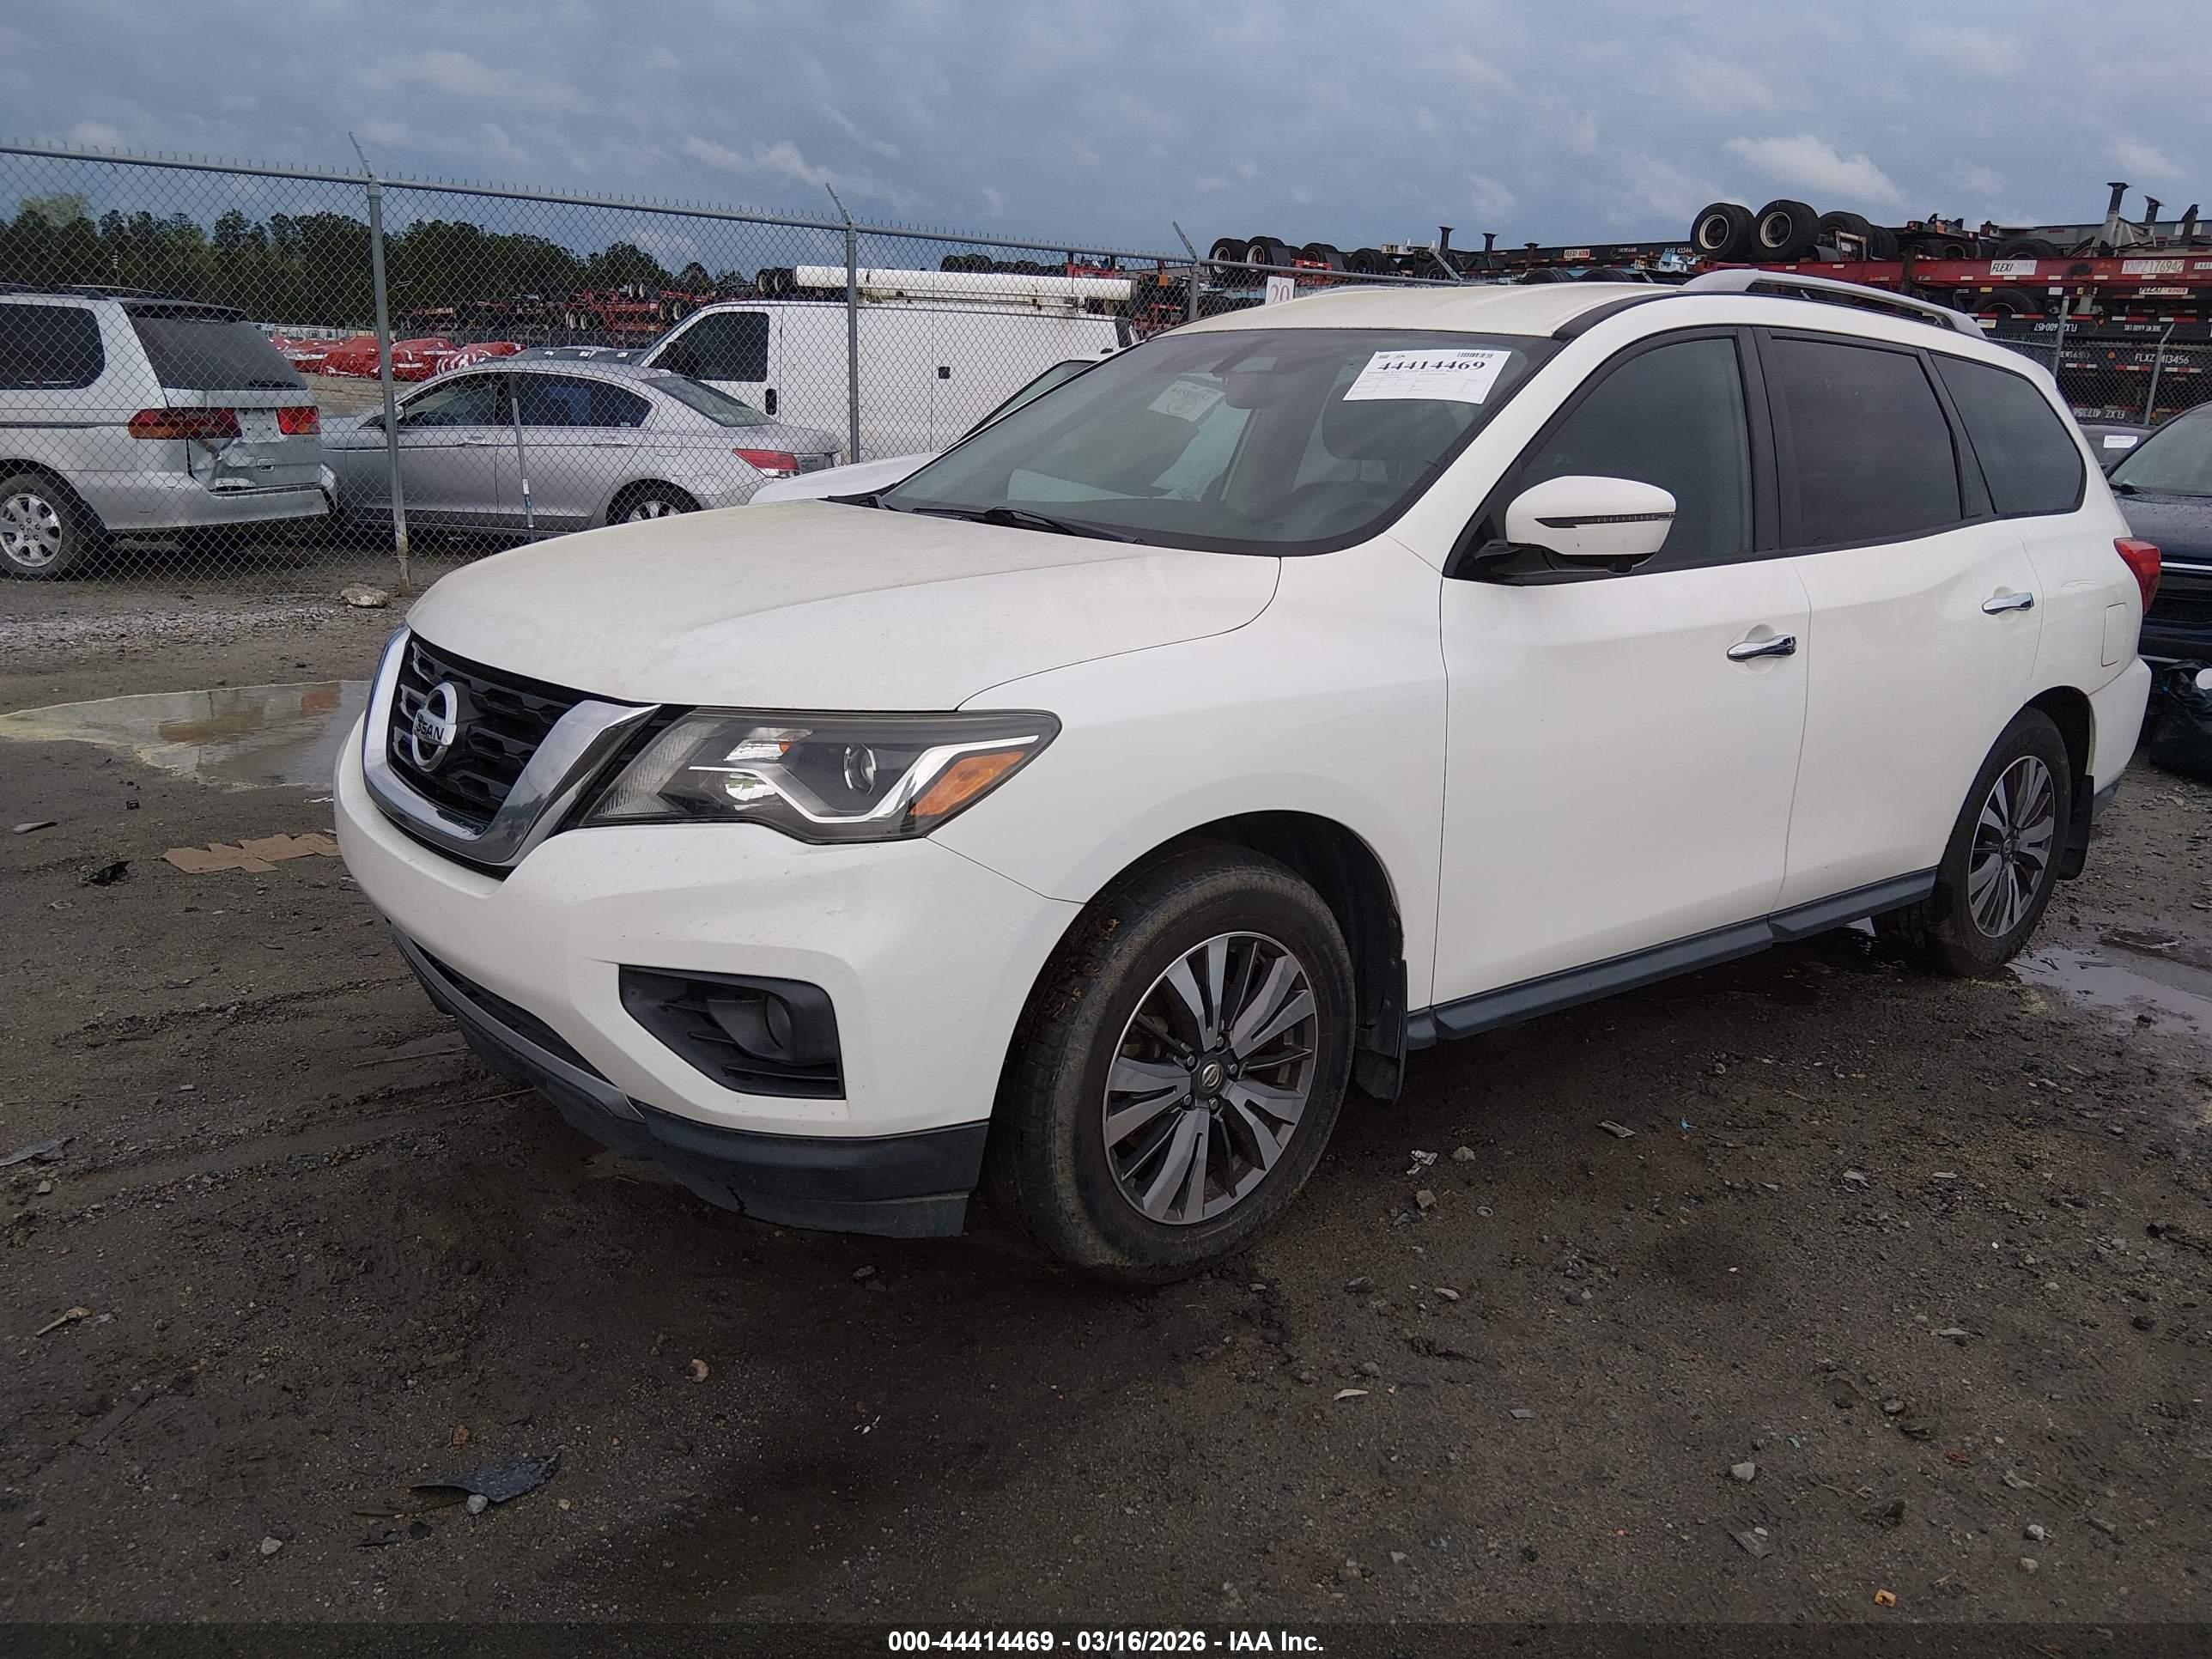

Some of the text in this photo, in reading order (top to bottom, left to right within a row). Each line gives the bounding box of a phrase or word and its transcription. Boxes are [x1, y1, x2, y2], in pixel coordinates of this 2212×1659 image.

[1271, 284, 1290, 303] 20
[2135, 353, 2155, 362] FLXZ
[1377, 361, 1486, 370] 44414469
